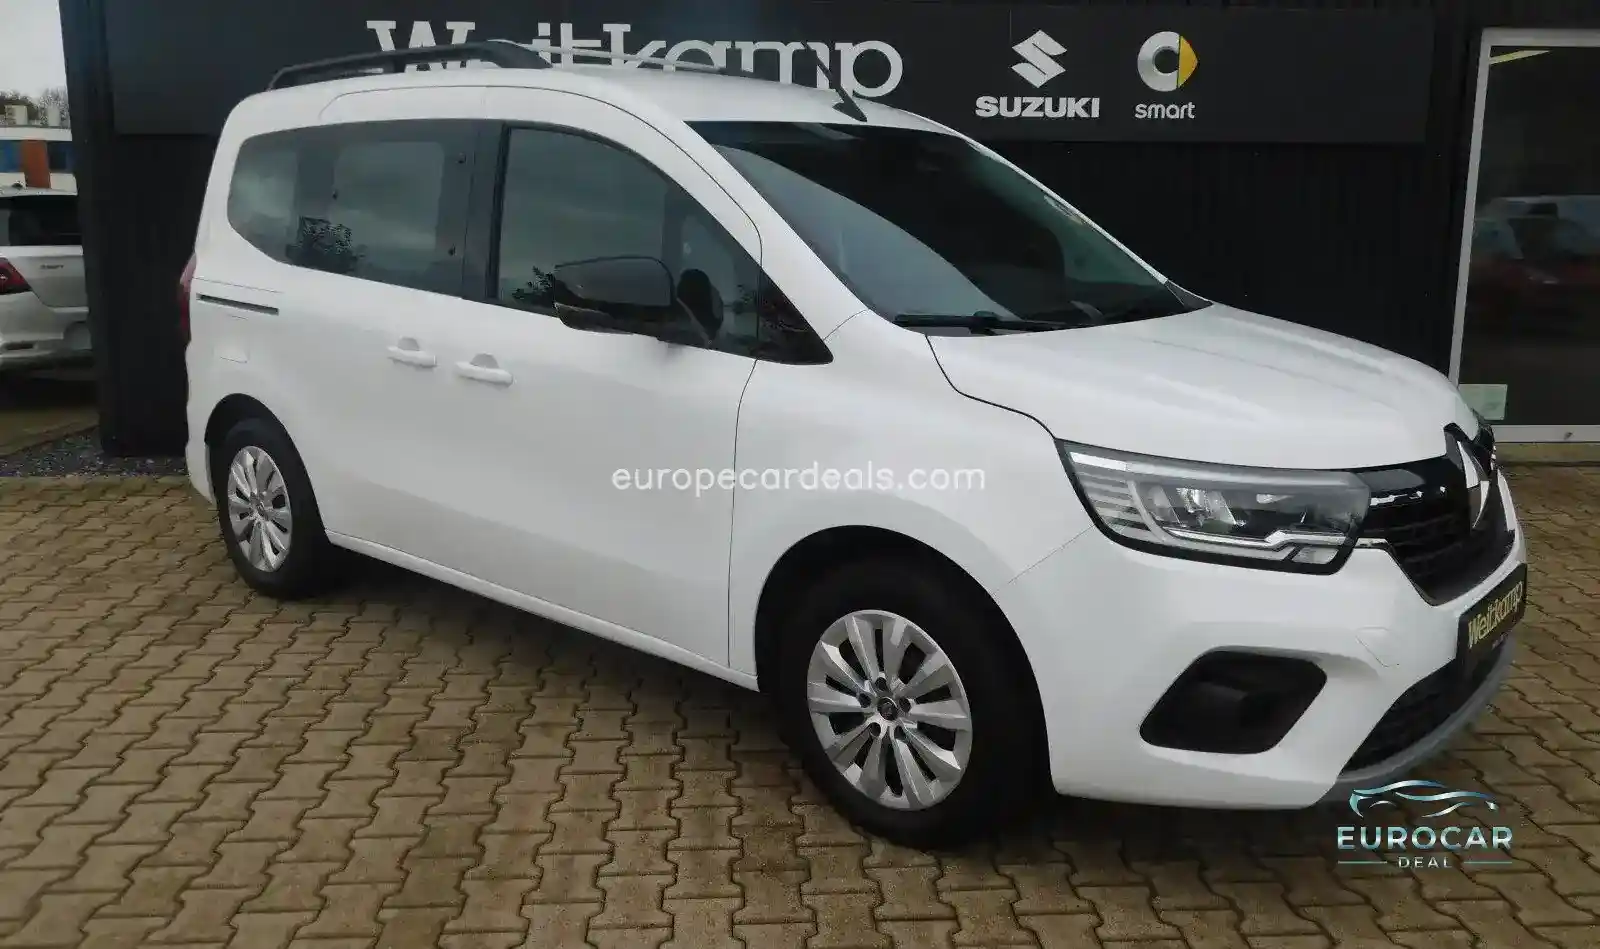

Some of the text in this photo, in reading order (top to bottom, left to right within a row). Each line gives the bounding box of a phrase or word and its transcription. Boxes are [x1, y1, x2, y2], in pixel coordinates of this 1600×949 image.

[367, 21, 903, 98] Witkamp
[975, 95, 1100, 118] SUZUKI
[1134, 101, 1196, 119] smart
